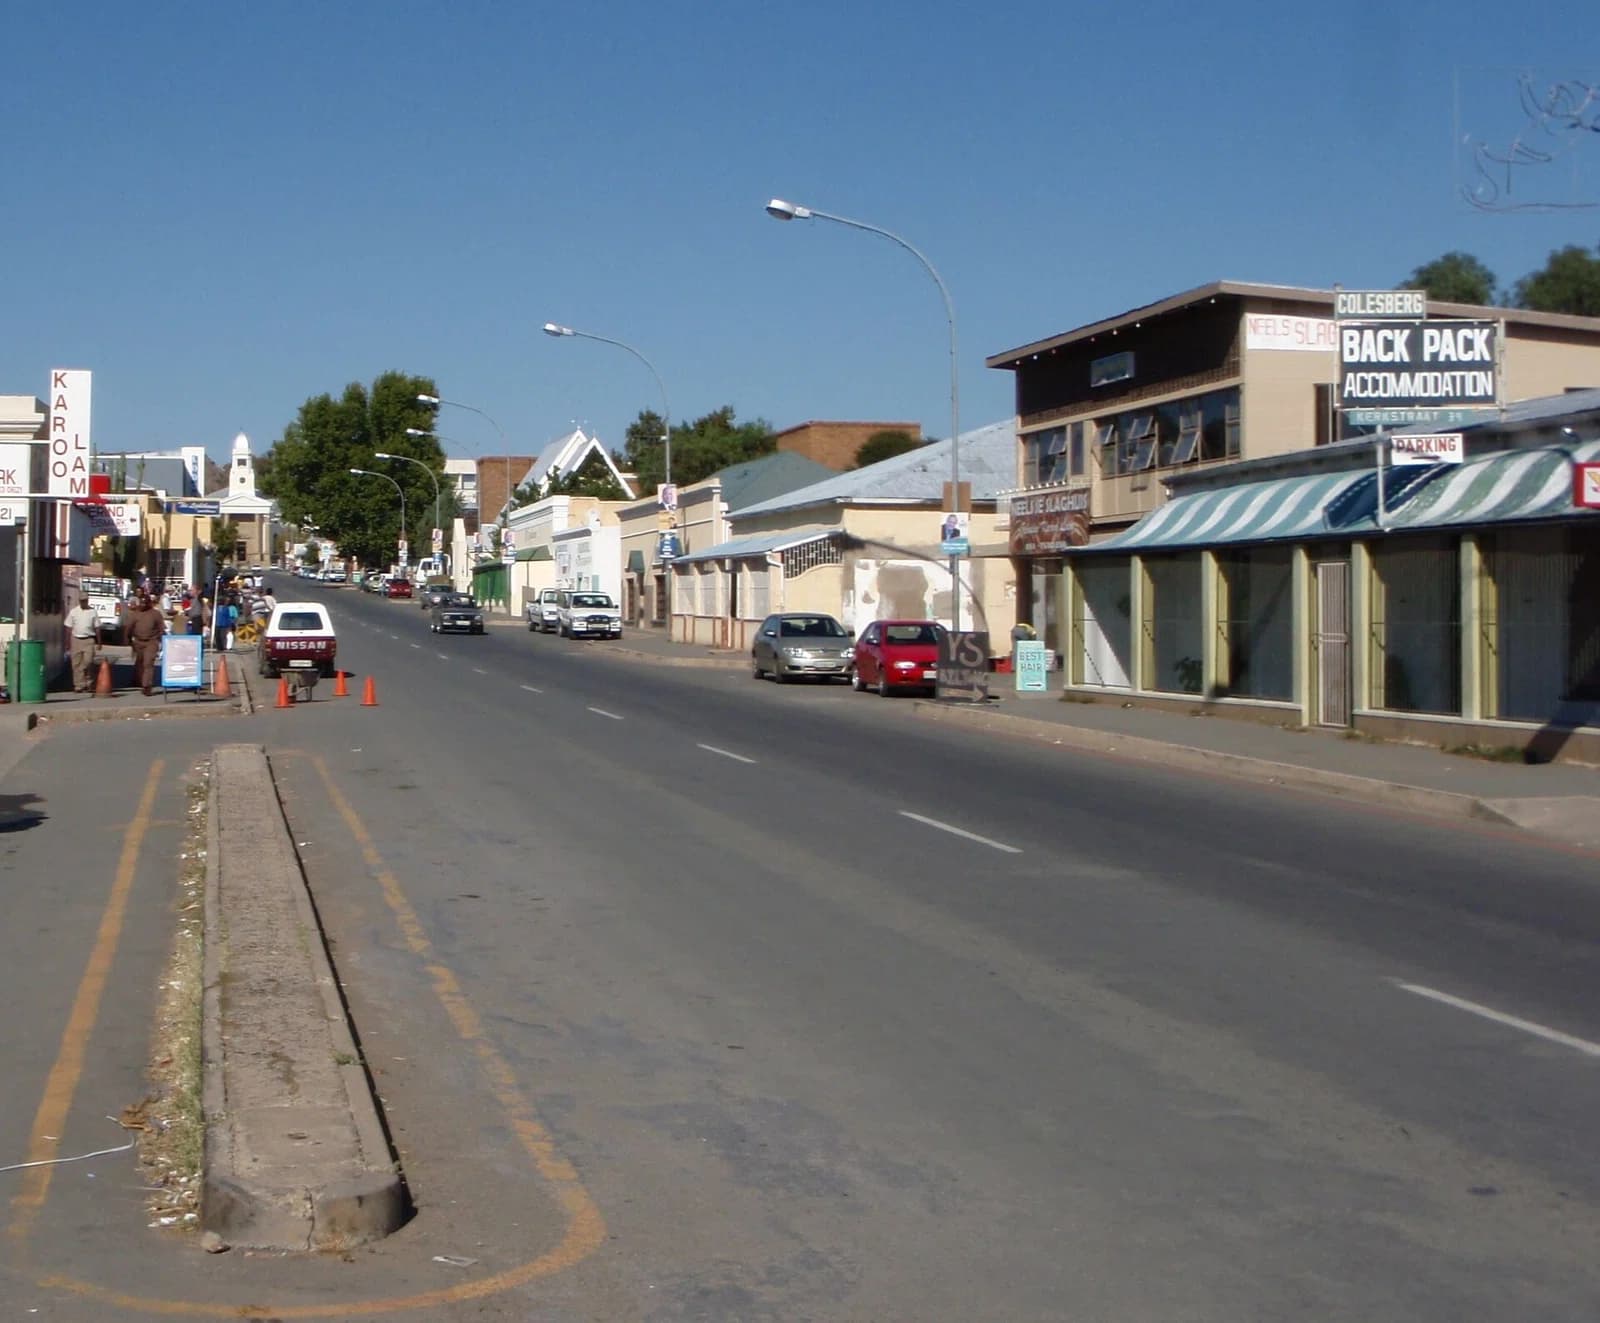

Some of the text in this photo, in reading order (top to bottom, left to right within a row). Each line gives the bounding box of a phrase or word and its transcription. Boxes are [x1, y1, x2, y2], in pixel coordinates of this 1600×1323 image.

[1337, 293, 1423, 314] COLESBERG
[1248, 318, 1290, 336] NEELS
[1342, 328, 1491, 362] BACK PACK
[1343, 371, 1493, 398] ACCOMMODATION
[52, 372, 68, 477] KAROO
[1395, 437, 1457, 453] PARKING
[70, 434, 86, 494] LAM
[276, 641, 326, 650] NISSAN
[947, 633, 984, 668] YS
[1019, 651, 1042, 661] BEST
[1020, 663, 1043, 673] HAIR
